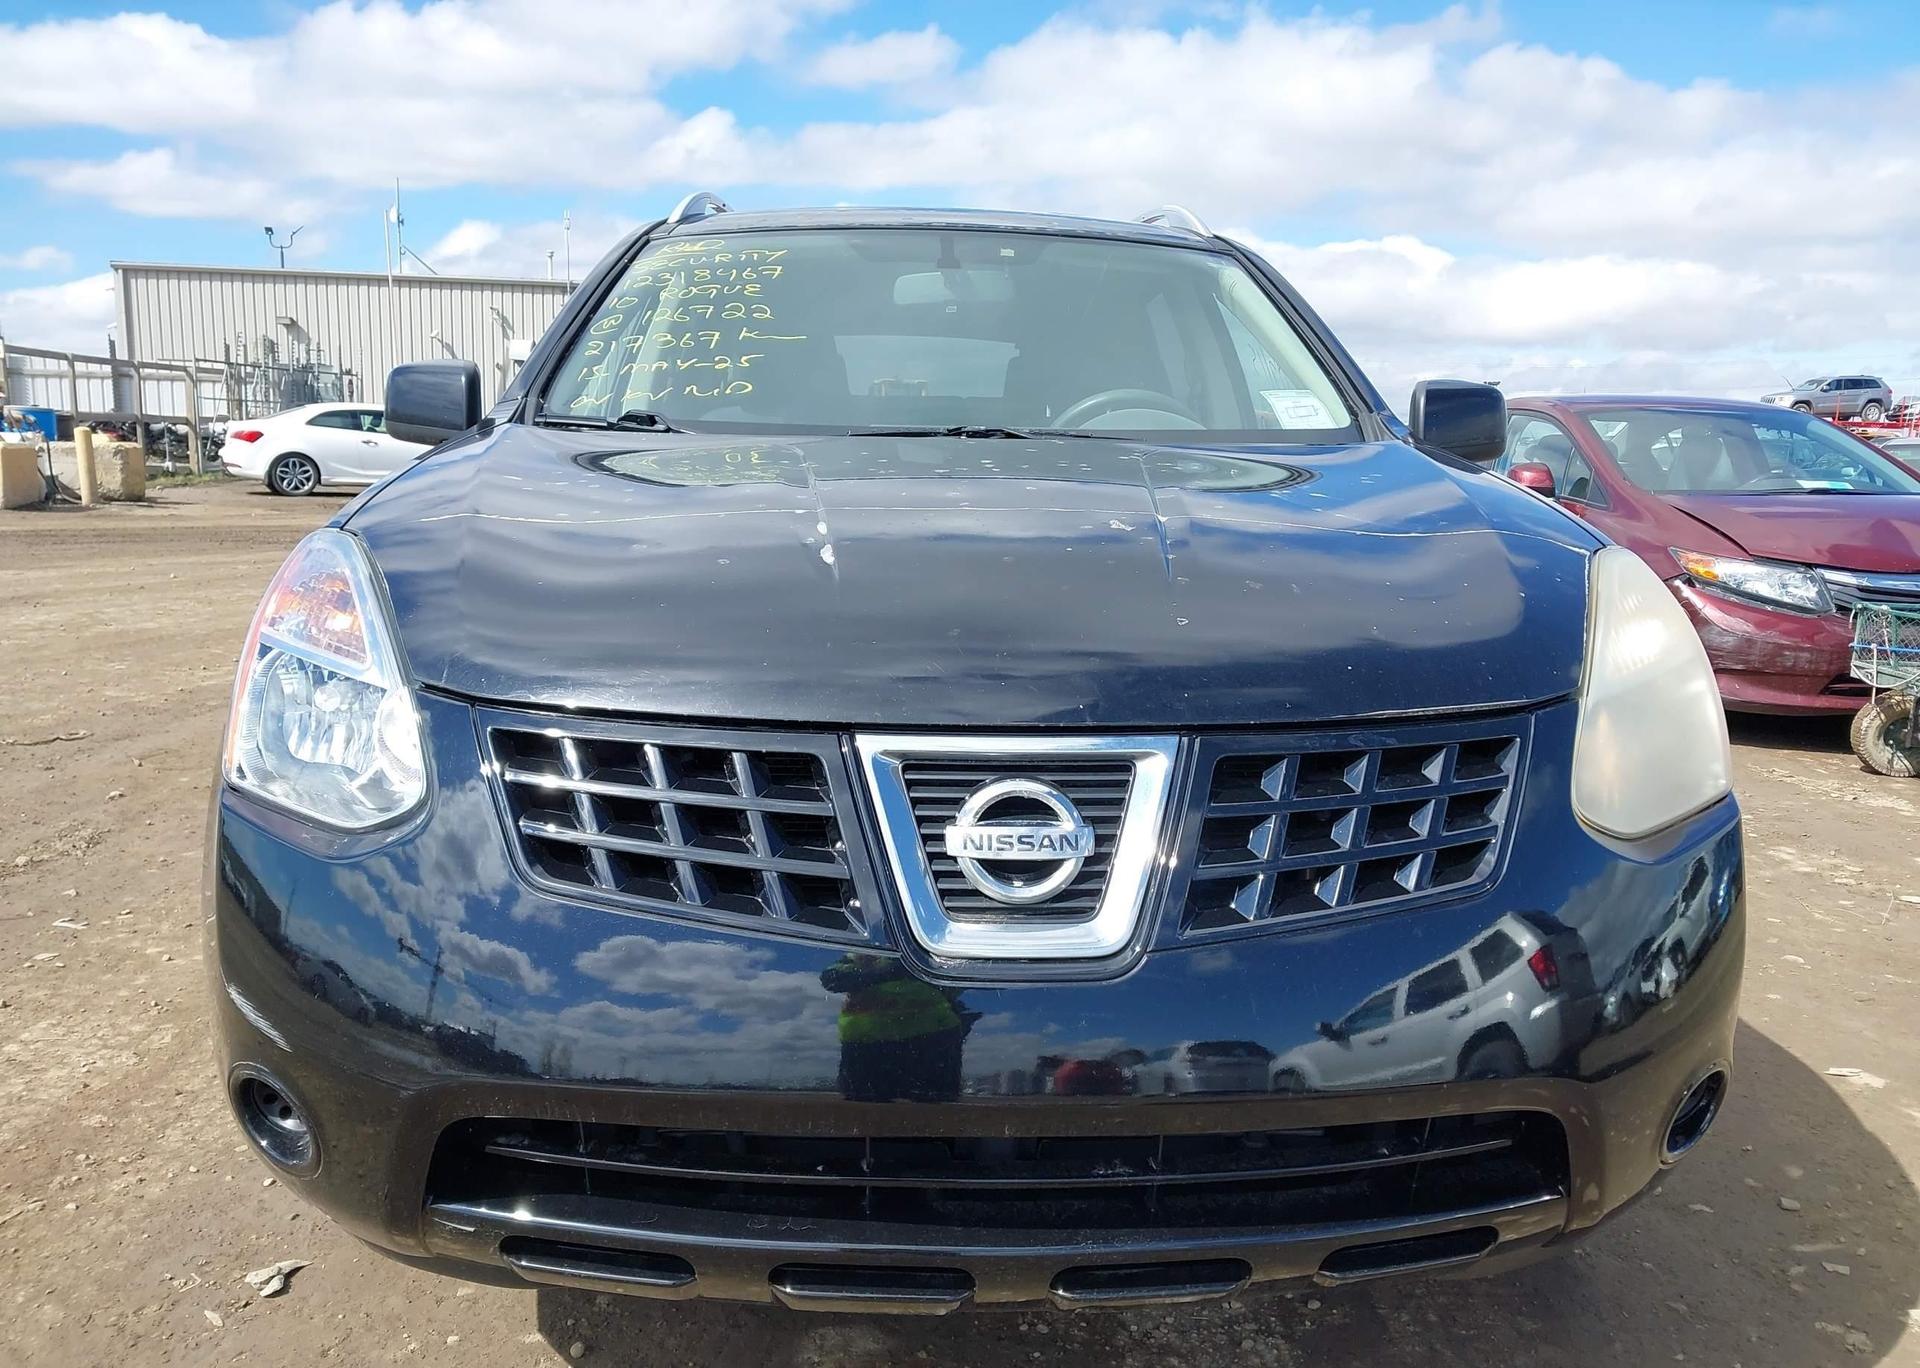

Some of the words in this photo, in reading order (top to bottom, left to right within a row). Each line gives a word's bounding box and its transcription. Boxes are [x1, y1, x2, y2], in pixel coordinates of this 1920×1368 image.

[623, 265, 784, 291] 12318467
[659, 283, 765, 301] ROGUE
[641, 302, 775, 326] 126722
[962, 833, 1080, 852] NISSAN
